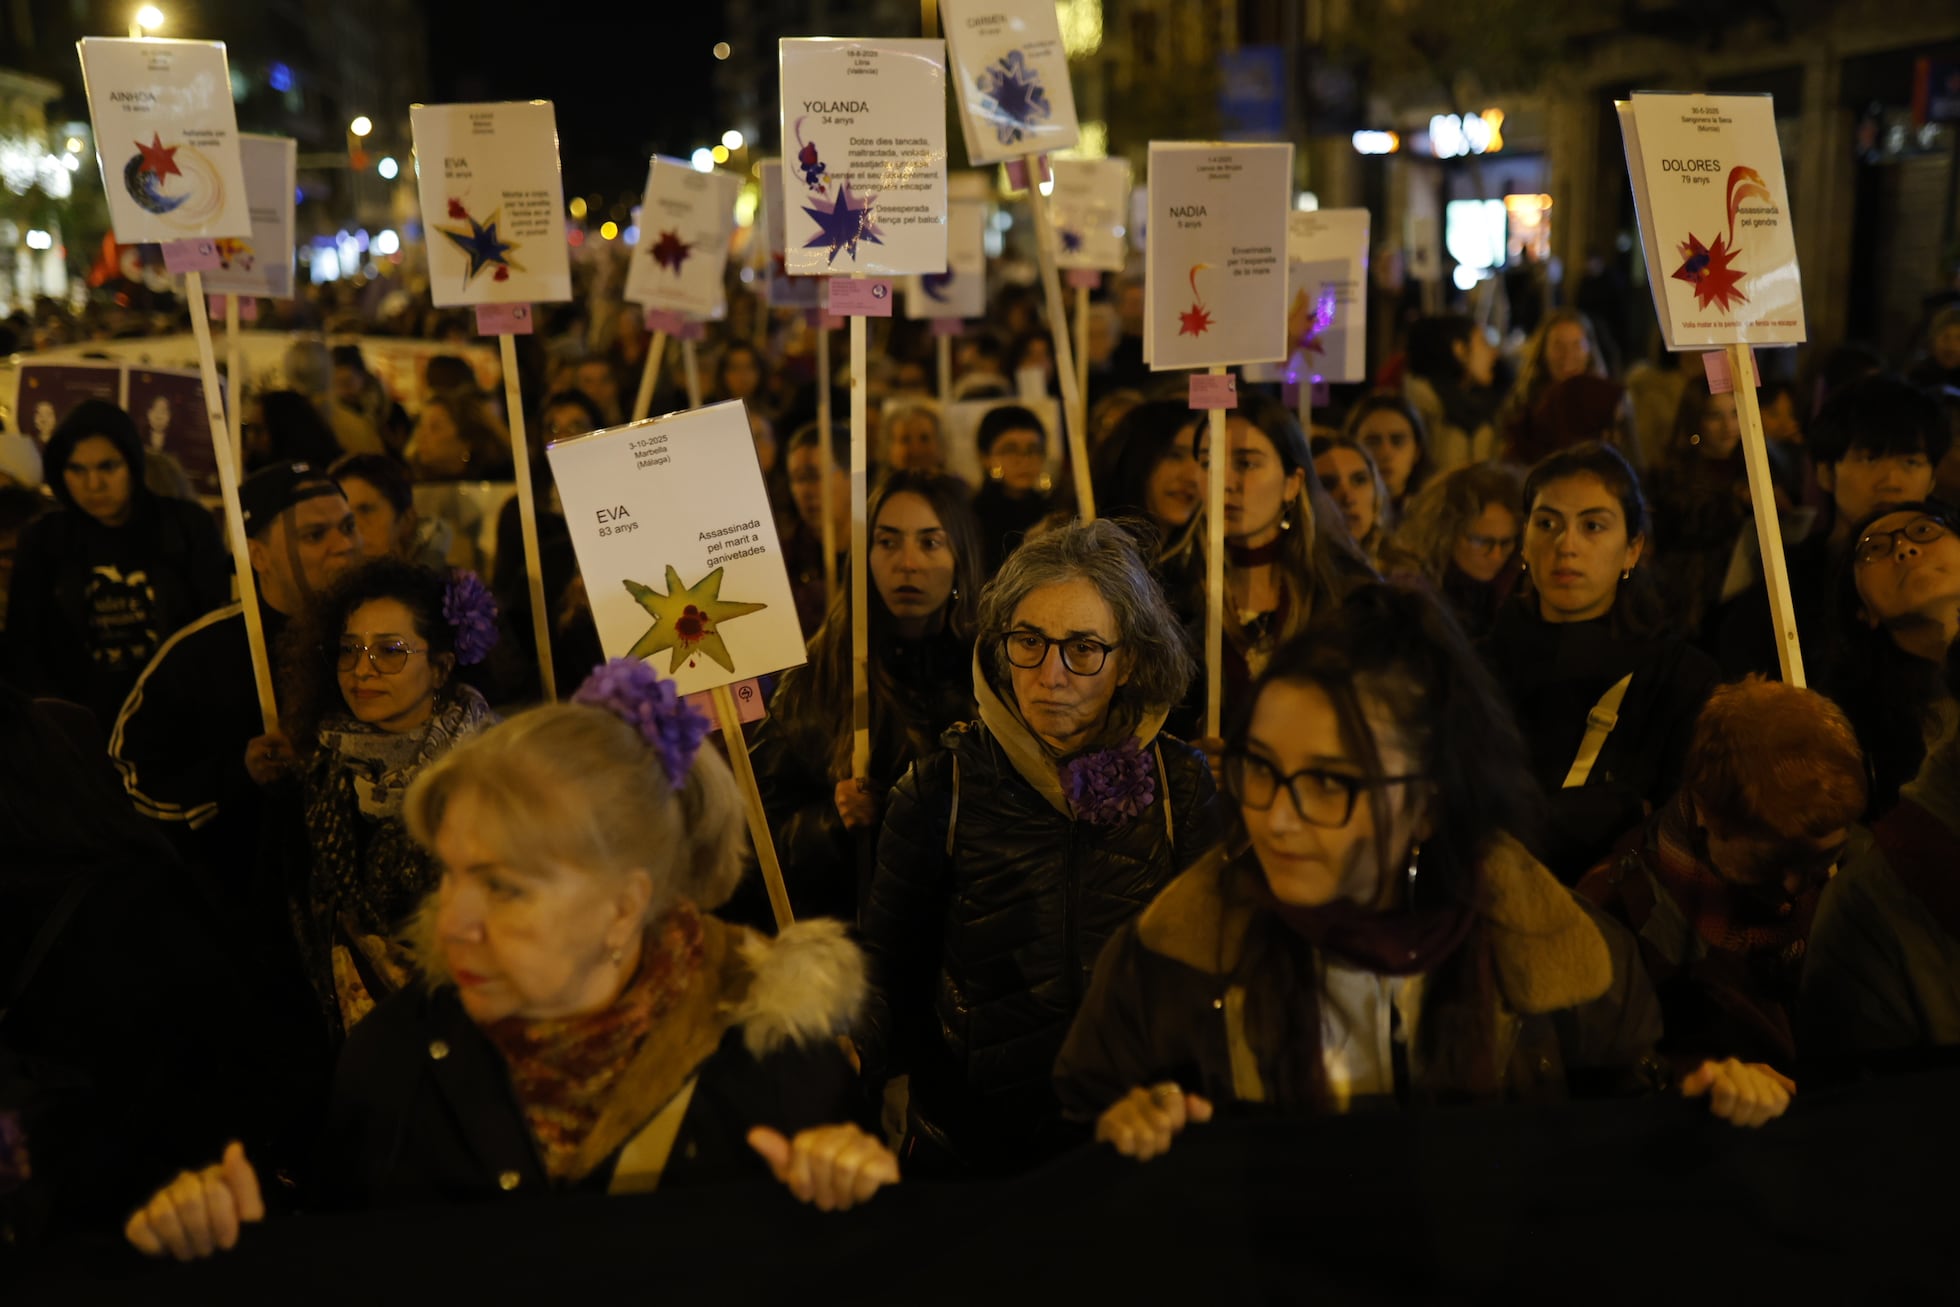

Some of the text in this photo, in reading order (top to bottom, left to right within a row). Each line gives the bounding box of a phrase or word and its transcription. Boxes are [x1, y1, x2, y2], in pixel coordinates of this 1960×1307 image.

[803, 101, 869, 113] YOLANDA
[822, 116, 854, 126] 34 anys
[850, 138, 874, 146] Dotze
[876, 138, 893, 146] dies
[444, 158, 468, 168] EVA
[1662, 159, 1721, 172] DOLORES
[1681, 175, 1710, 186] 79 anys
[876, 205, 929, 214] Desesperada
[1169, 206, 1207, 218] NADIA
[904, 216, 916, 225] pel
[1184, 221, 1202, 229] anys
[1741, 218, 1778, 228] pel gendre
[629, 434, 668, 450] 3-10-2025
[634, 446, 668, 459] Marbella
[637, 455, 671, 470] (Málaga)
[596, 505, 630, 524] EVA
[598, 520, 639, 537] 83 anys
[698, 519, 761, 542] Assassinada
[707, 533, 759, 555] pel marit a
[706, 544, 766, 568] ganivetades
